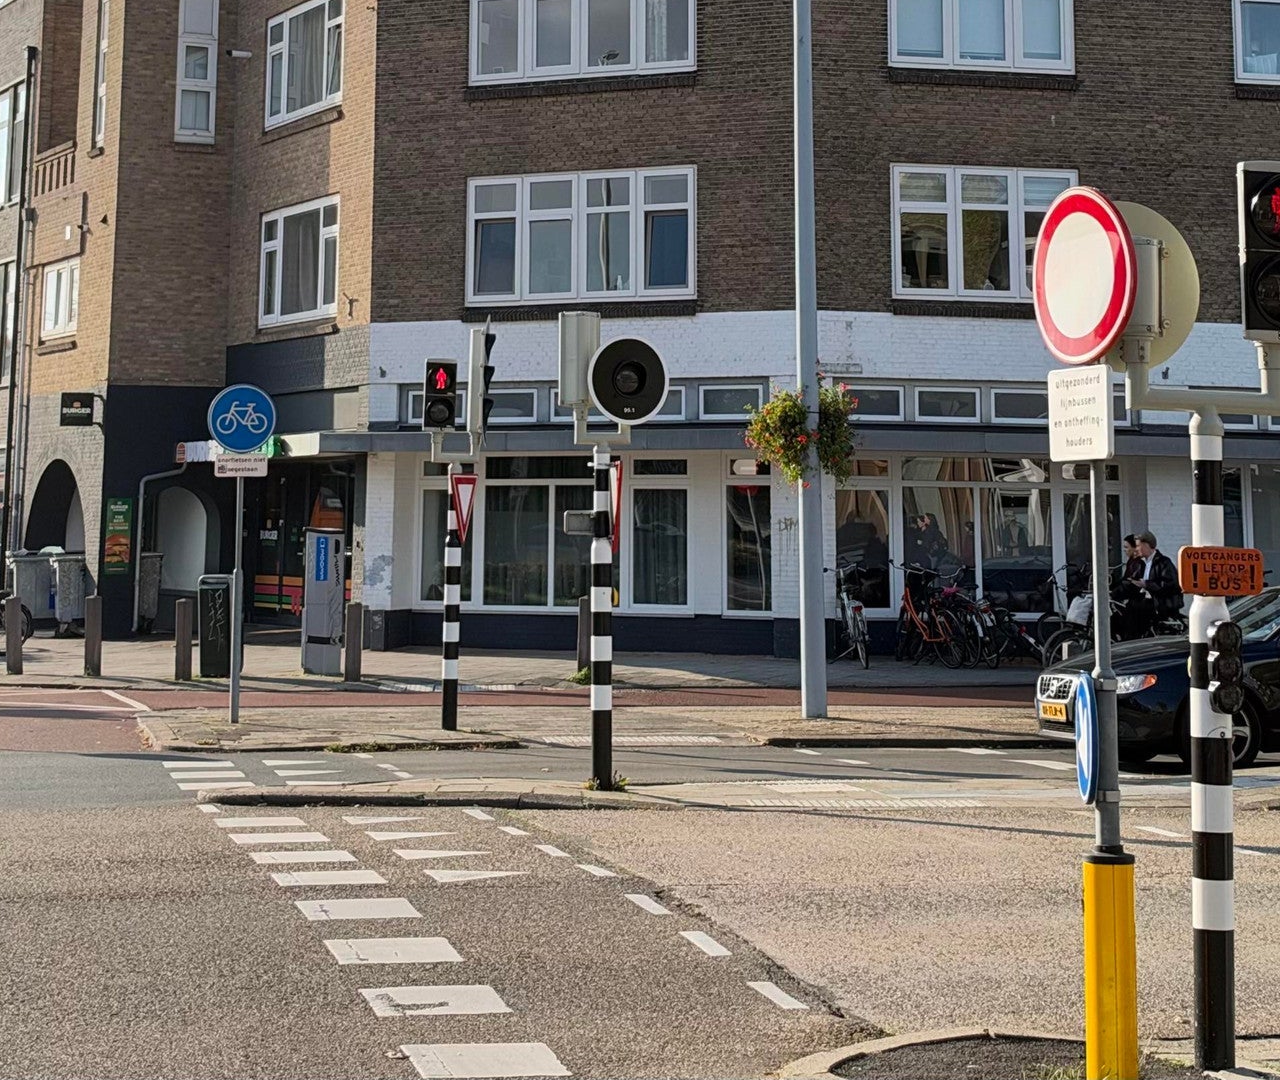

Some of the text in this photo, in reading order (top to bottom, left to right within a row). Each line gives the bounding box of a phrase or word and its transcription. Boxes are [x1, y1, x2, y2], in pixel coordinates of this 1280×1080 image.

[1055, 374, 1101, 390] uitgezonderd
[1060, 396, 1096, 410] lijnbussen
[1065, 437, 1093, 447] houders
[1185, 551, 1260, 562] VOETGANGERS
[1203, 563, 1245, 573] LET OP
[1208, 577, 1242, 590] BUS
